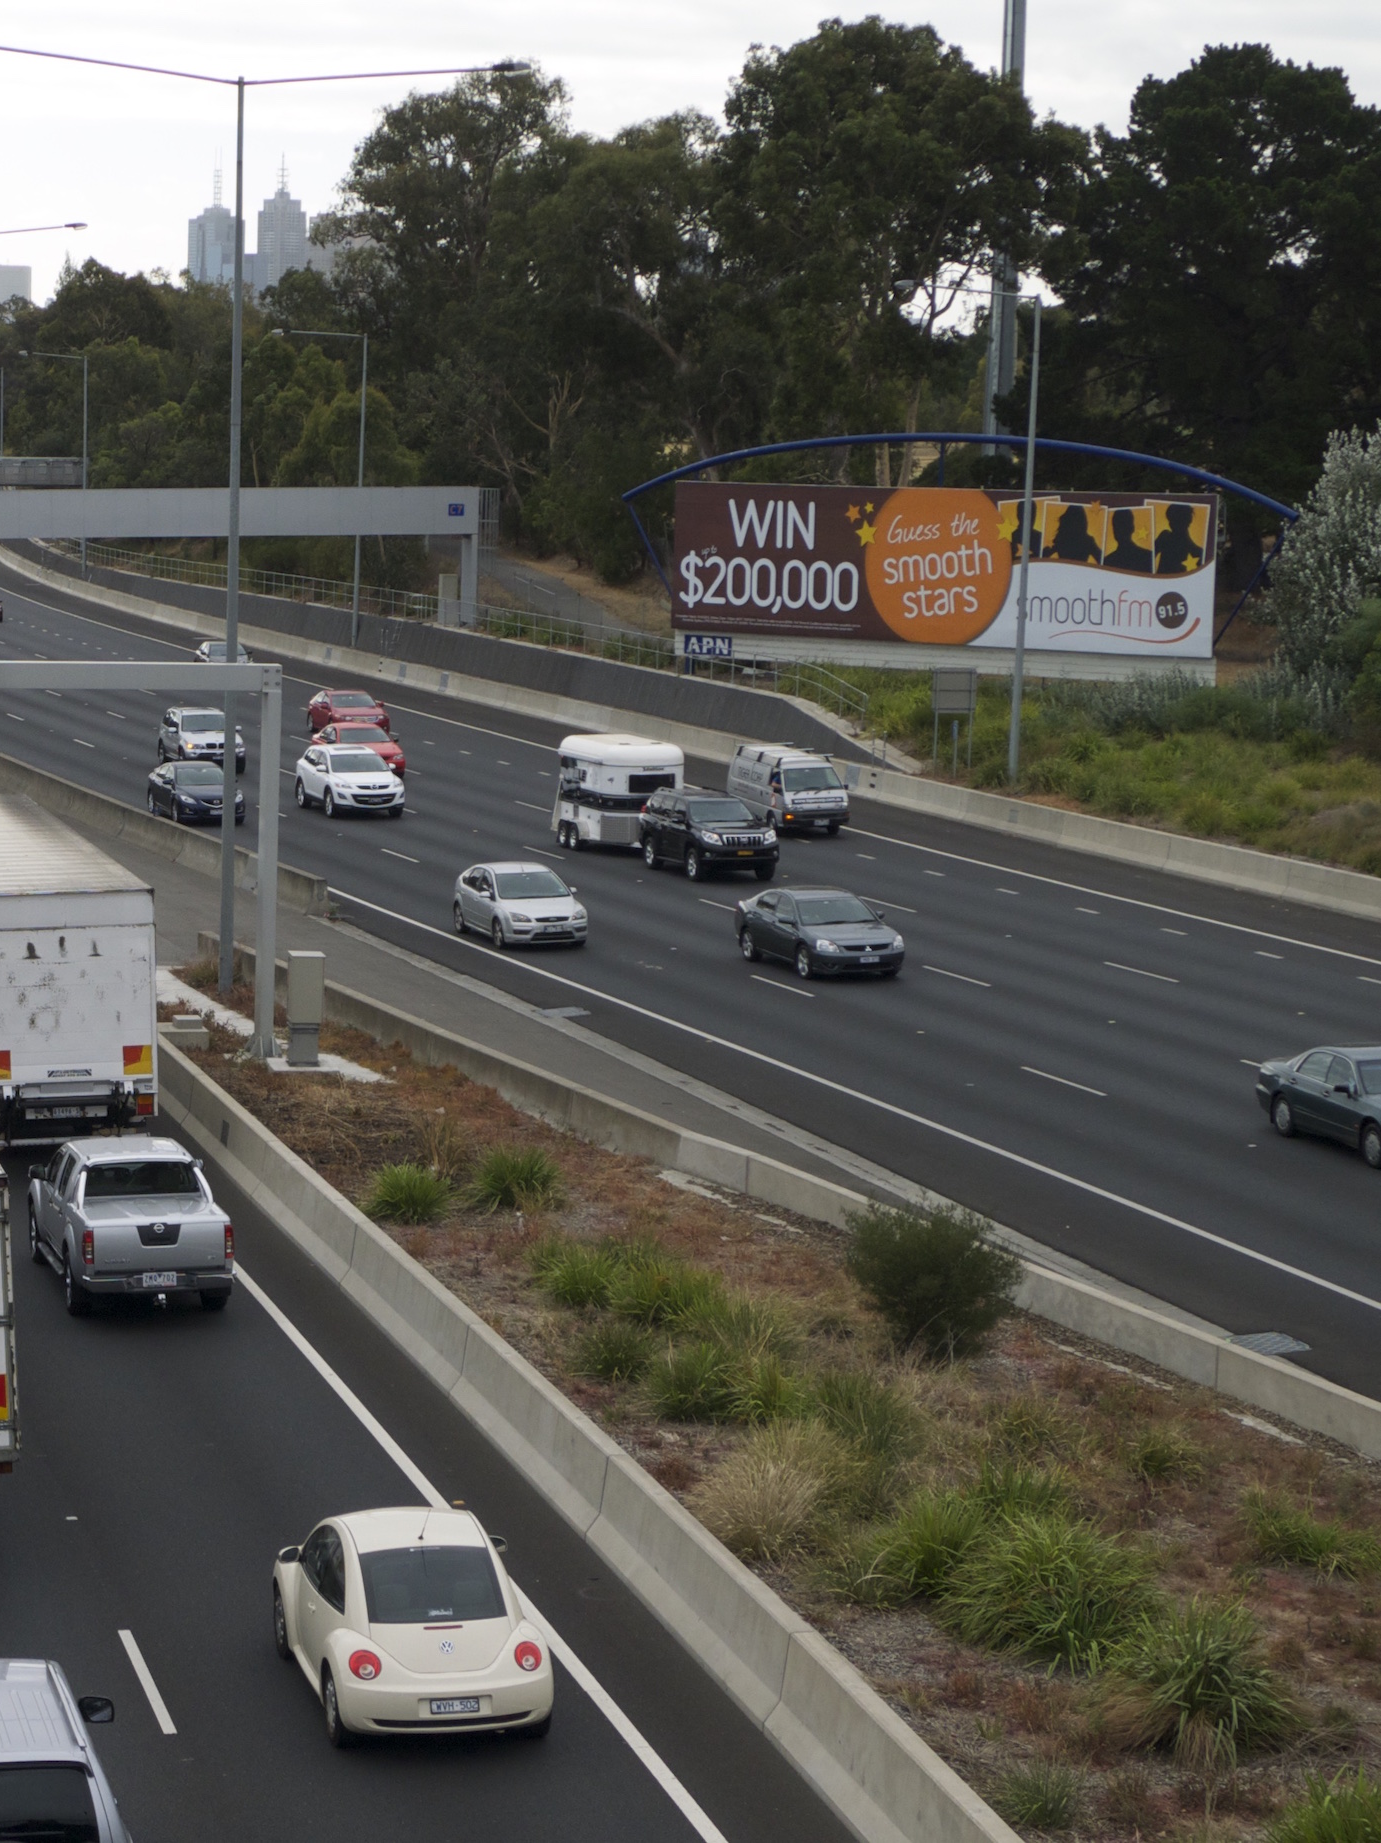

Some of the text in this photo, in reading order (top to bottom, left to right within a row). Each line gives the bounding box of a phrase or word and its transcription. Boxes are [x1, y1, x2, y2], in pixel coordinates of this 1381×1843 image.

[728, 498, 815, 550] WIN
[887, 511, 980, 544] Guess the
[883, 540, 993, 585] smooth
[679, 550, 859, 614] $200,000
[903, 584, 979, 619] stars
[1158, 602, 1185, 619] 91.5
[687, 636, 732, 655] APN
